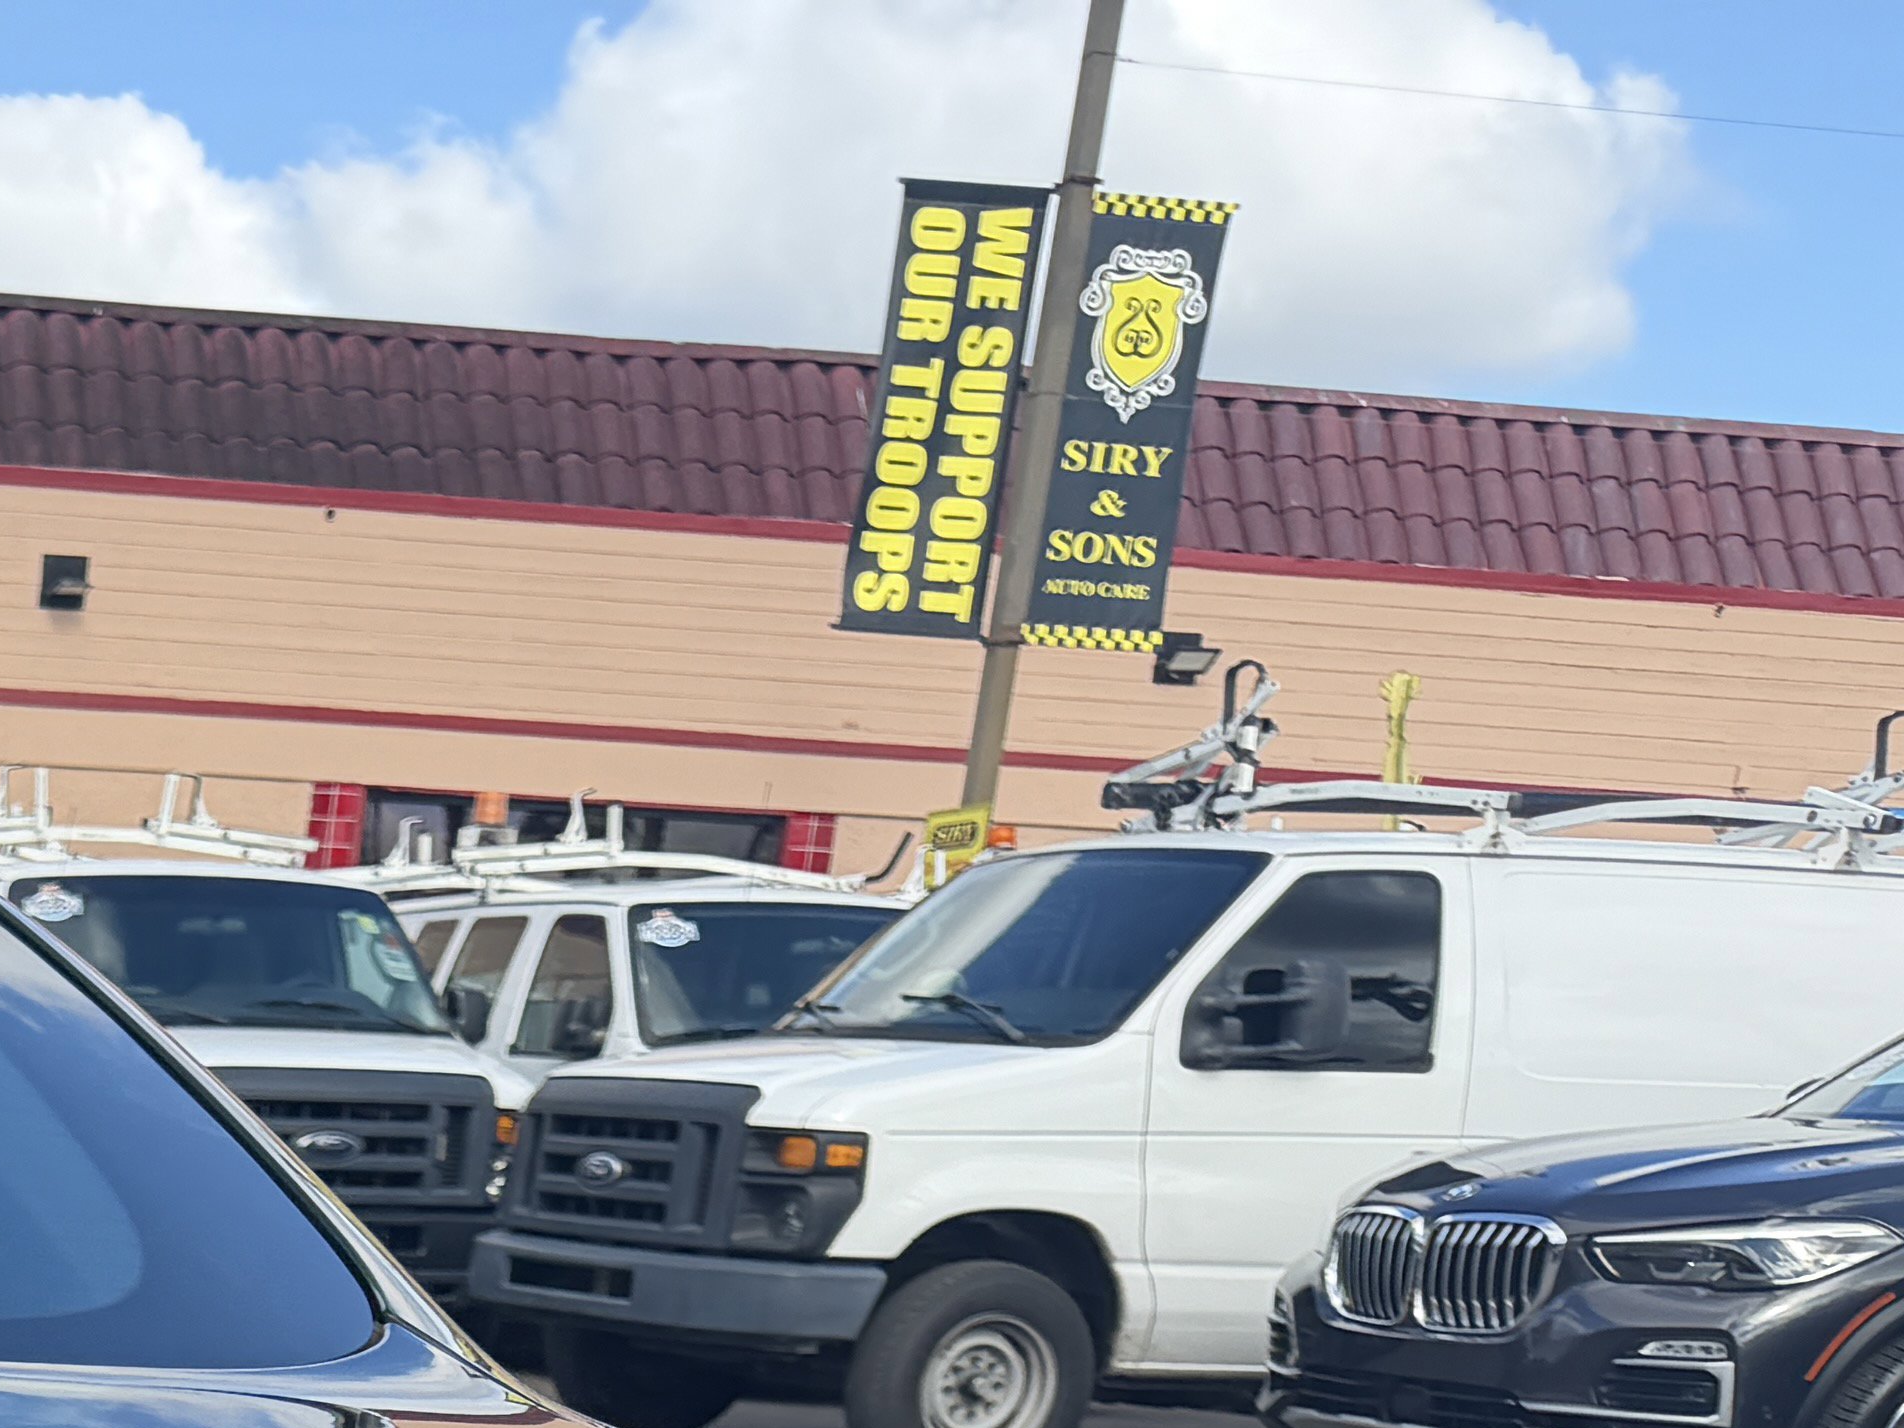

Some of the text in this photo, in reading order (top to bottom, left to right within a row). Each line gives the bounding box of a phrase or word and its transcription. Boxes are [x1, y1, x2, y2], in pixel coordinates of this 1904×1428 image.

[853, 206, 966, 613] OUR TROOPS
[919, 207, 1034, 623] WE SUPPORT
[1060, 439, 1172, 478] SIRY
[1090, 489, 1127, 518] &
[1045, 530, 1157, 567] SONS
[1042, 578, 1150, 601] AUTO CARE
